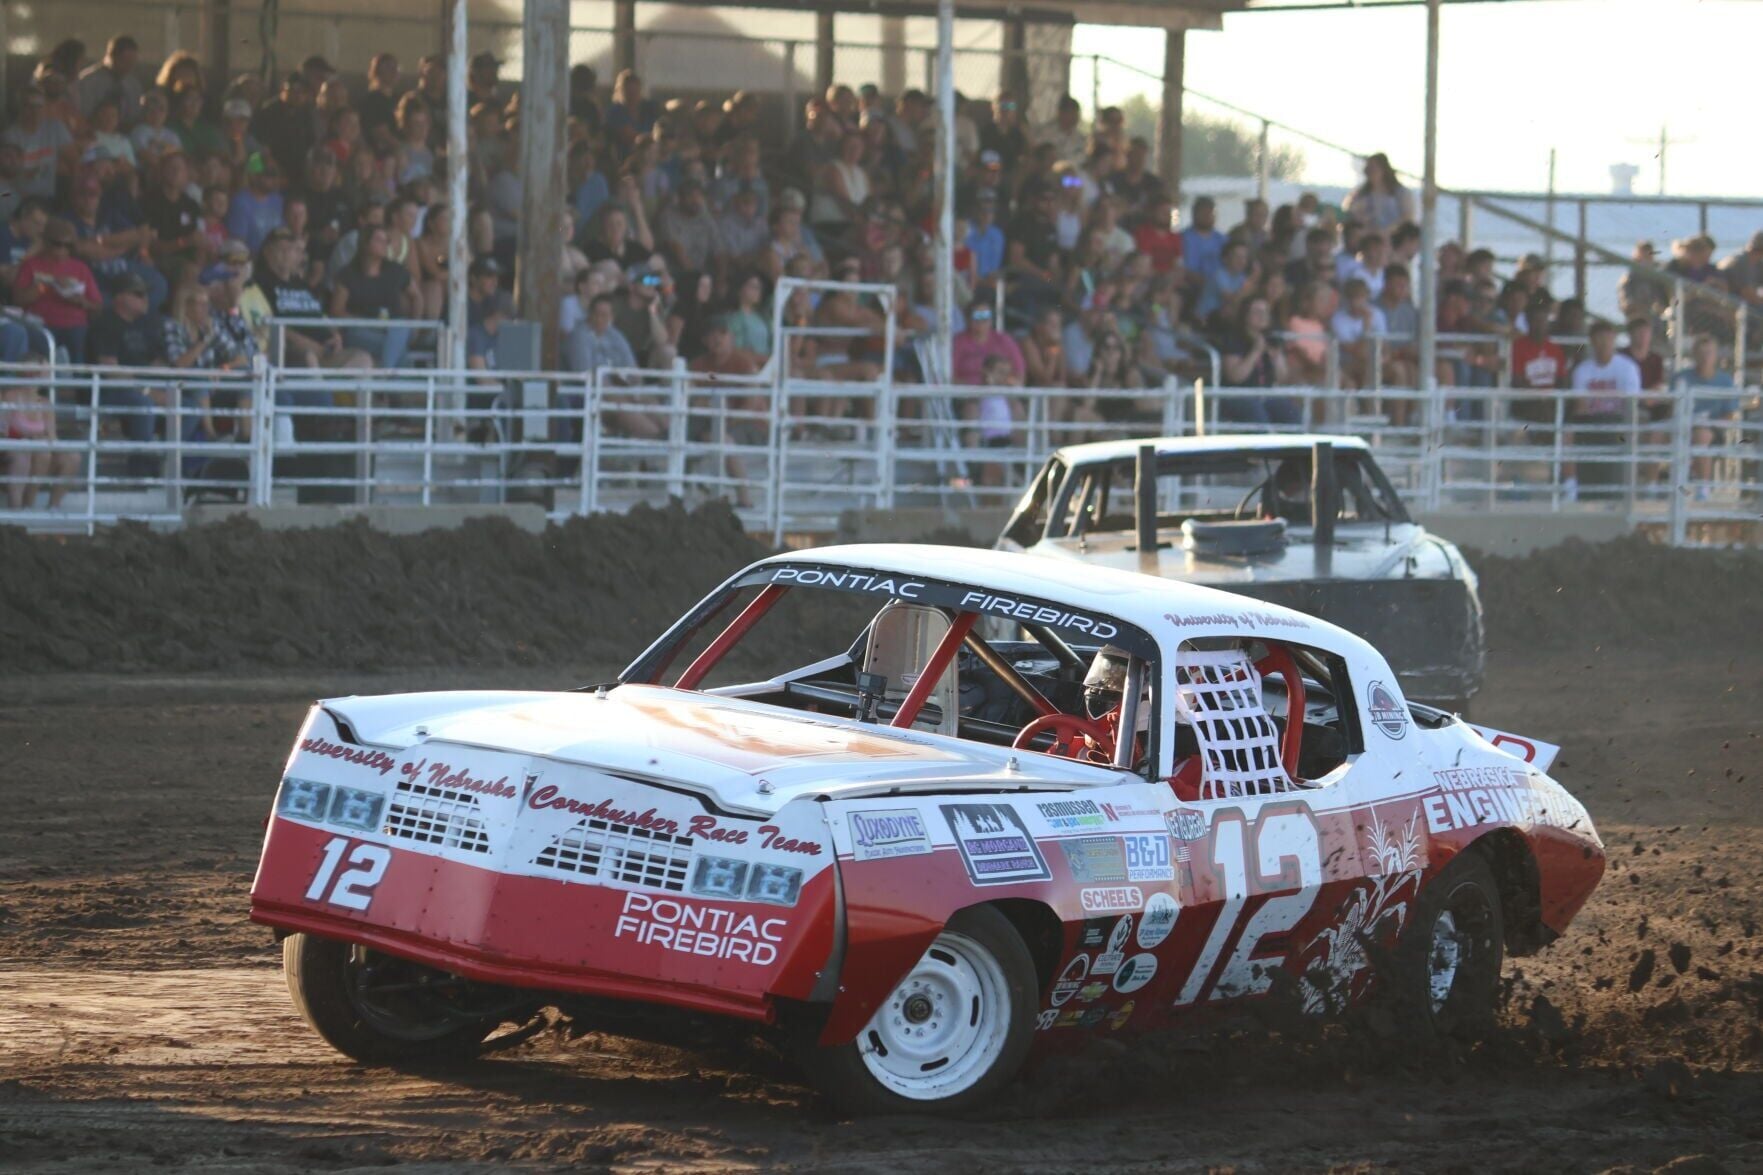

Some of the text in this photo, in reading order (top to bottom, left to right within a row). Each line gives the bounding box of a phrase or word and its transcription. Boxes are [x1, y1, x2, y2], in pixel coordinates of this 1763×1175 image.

[771, 568, 1118, 639] PONTIAC FIREBIRD
[1163, 613, 1239, 629] University
[1238, 612, 1255, 630] of
[401, 757, 427, 783] of
[427, 762, 519, 799] Nebraska
[1434, 766, 1519, 792] NEBRASKA
[528, 785, 822, 857] Cornhusker Race Team
[1036, 800, 1100, 818] rasmussen
[853, 813, 925, 847] LUXODYNE
[1125, 835, 1169, 867] B&D
[303, 835, 392, 912] 12
[1129, 868, 1174, 880] PERFORMANCE
[622, 892, 788, 942] PONTIAC
[1083, 889, 1141, 909] SCHEELS
[1173, 806, 1324, 1006] 12
[614, 915, 777, 966] FIREBIRD
